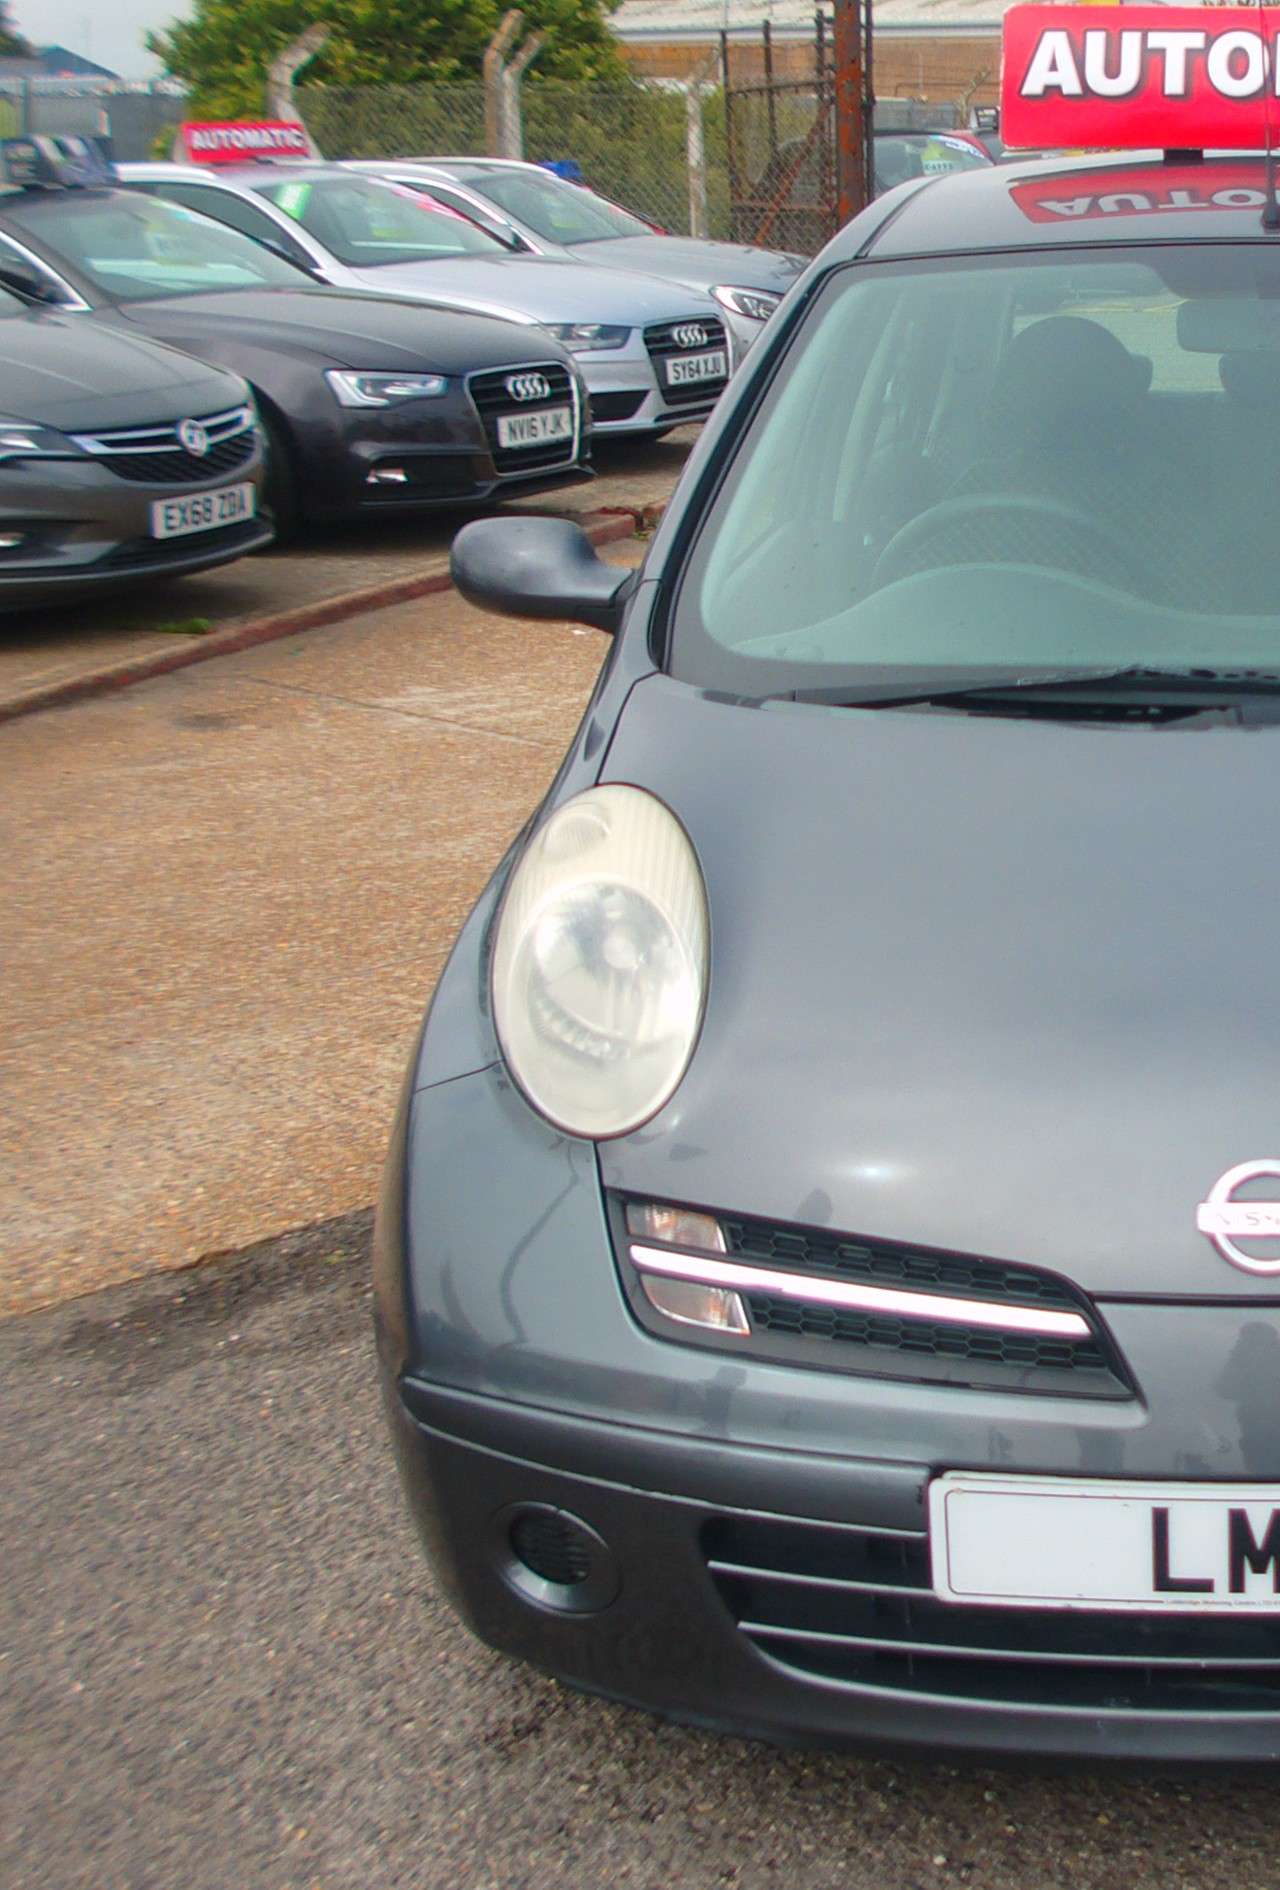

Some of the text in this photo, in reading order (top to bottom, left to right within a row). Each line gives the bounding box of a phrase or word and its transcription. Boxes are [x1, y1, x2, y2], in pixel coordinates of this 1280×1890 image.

[191, 128, 305, 149] AUTOMATIC
[672, 361, 700, 381] SY64
[507, 416, 538, 442] NV16
[164, 497, 213, 531] EX68
